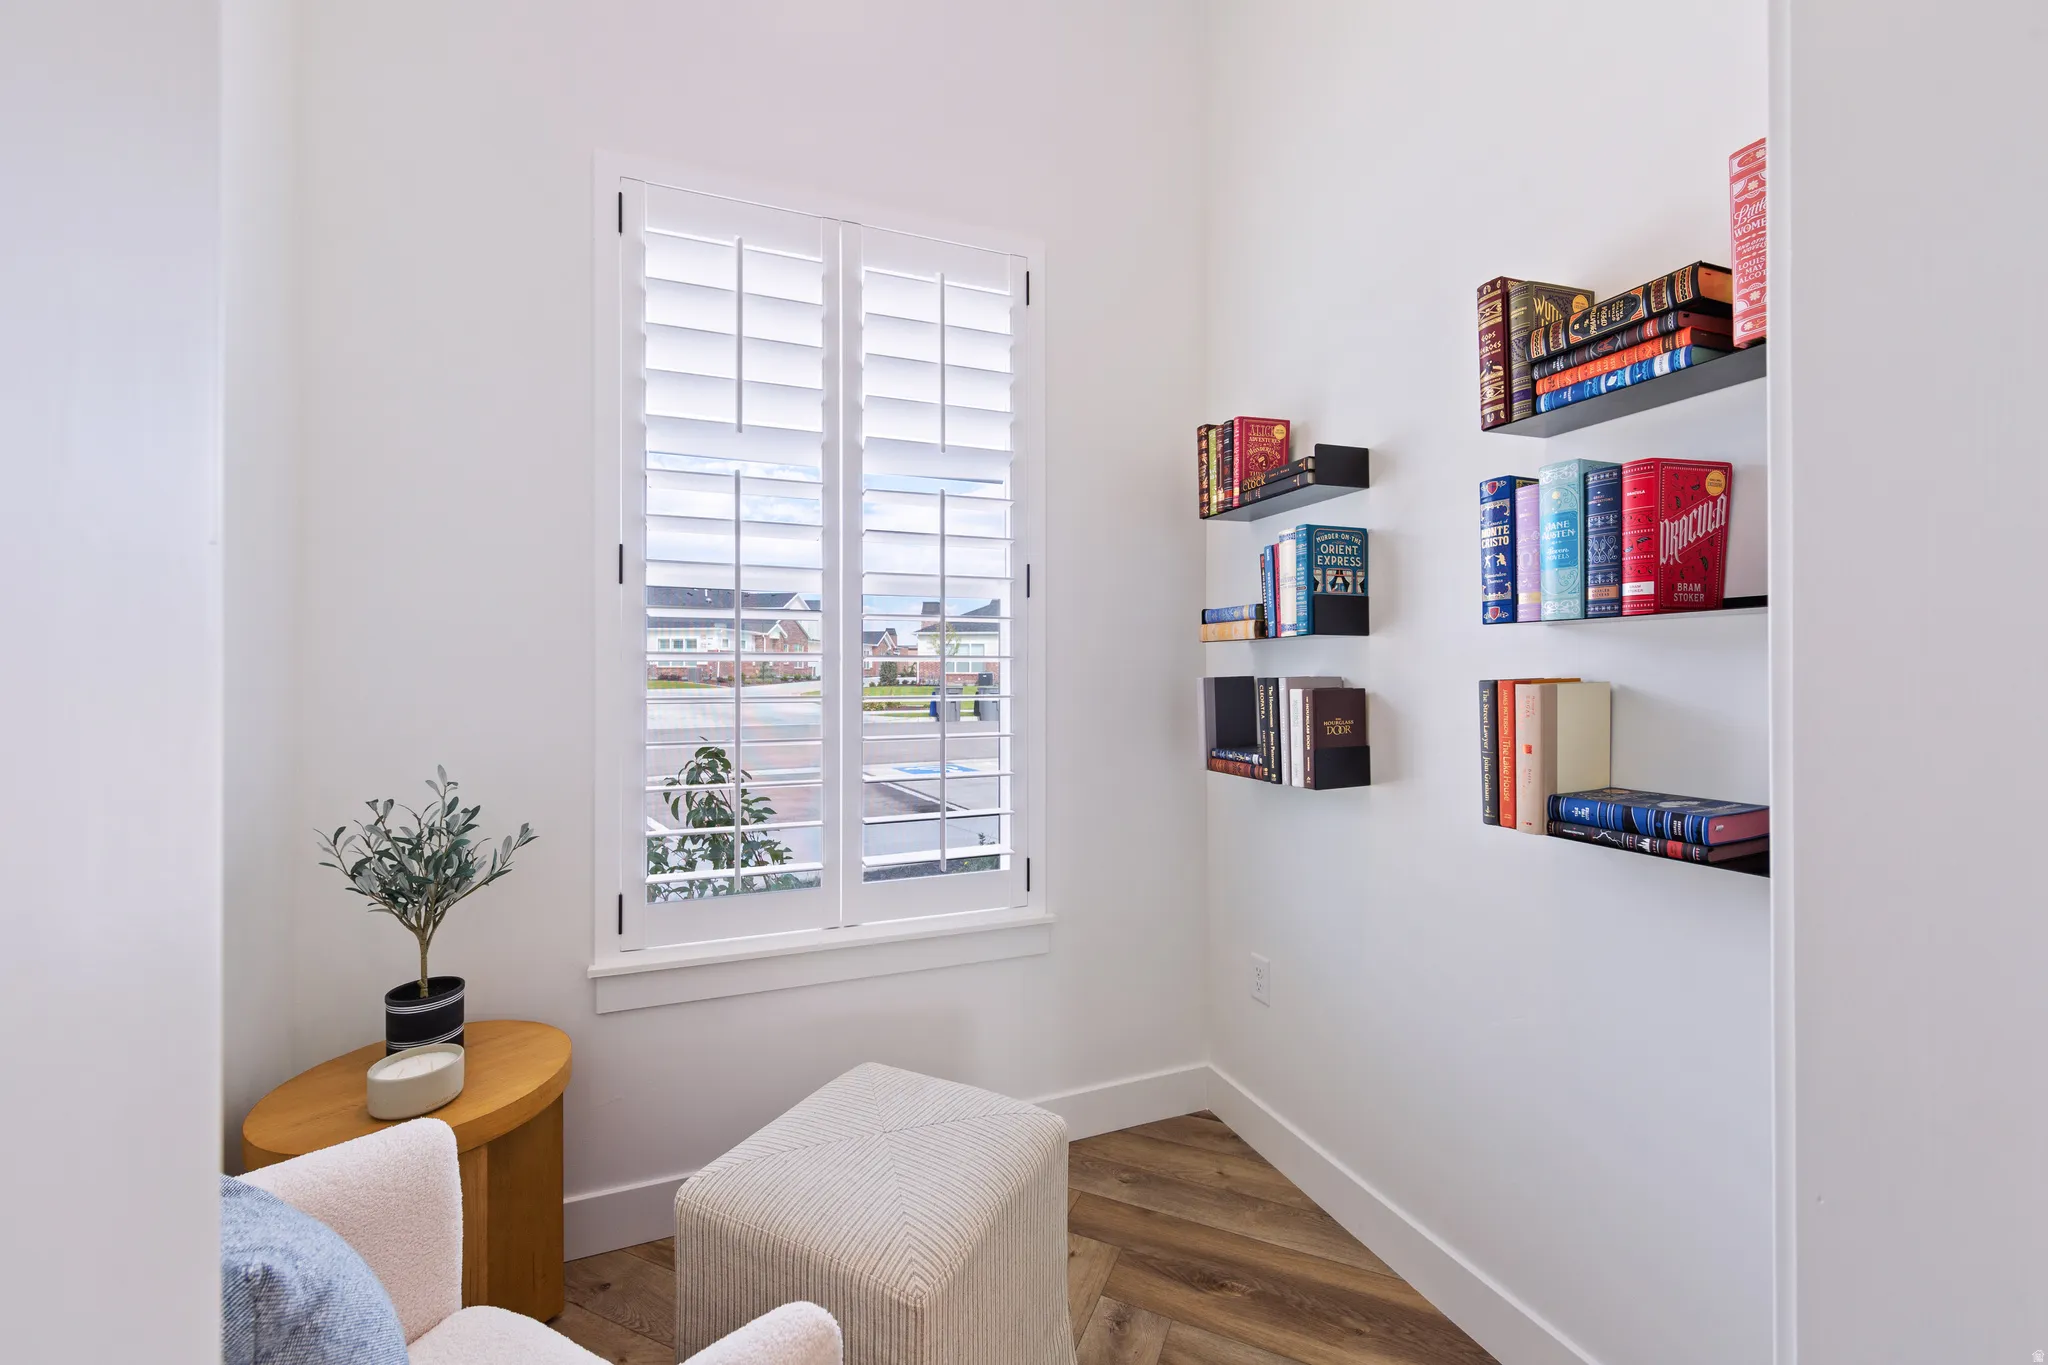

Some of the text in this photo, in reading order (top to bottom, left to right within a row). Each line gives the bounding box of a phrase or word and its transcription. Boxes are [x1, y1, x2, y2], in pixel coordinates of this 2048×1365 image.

[1734, 218, 1766, 238] WOME
[1738, 255, 1766, 271] LOUIS
[1745, 263, 1764, 275] MAY
[1739, 269, 1766, 284] ALCOT
[1481, 331, 1496, 342] GODS
[1242, 477, 1266, 491] CLOCK
[1545, 520, 1570, 530] JANE
[1660, 493, 1727, 565] DRACULA
[1482, 525, 1509, 538] MONTE
[1542, 528, 1575, 540] AUSTEN
[1316, 533, 1338, 543] MURDER
[1351, 536, 1361, 545] THE
[1482, 536, 1509, 549] CRISTO
[1320, 544, 1358, 555] ORIENT
[1317, 555, 1361, 567] EXPRESS
[1677, 583, 1701, 592] BRAM
[1673, 593, 1704, 602] STOKER
[1327, 725, 1352, 735] DOOR
[1481, 725, 1490, 749] Lawyer
[1502, 740, 1511, 801] The Lake House
[1483, 756, 1492, 801] John Grisham
